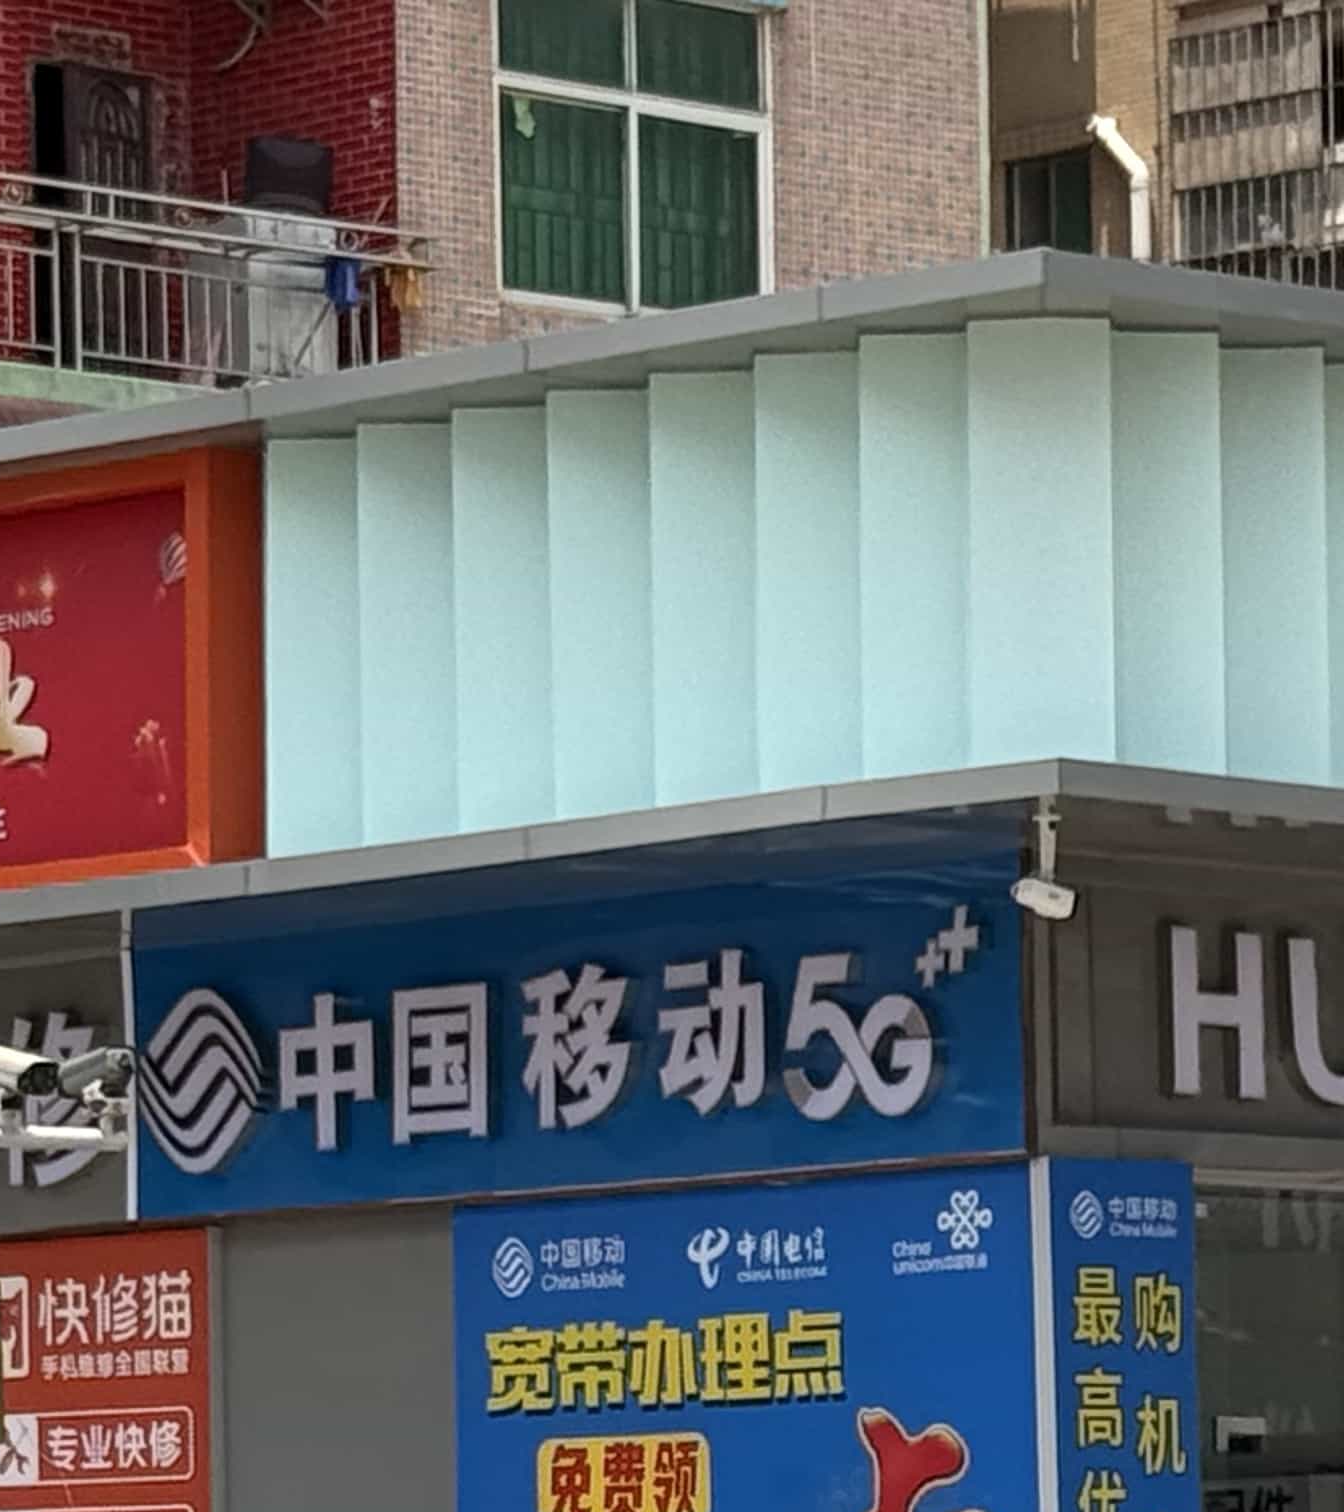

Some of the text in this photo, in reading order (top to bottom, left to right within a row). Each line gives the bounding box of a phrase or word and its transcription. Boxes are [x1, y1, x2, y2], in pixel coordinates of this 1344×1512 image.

[540, 1235, 626, 1269] 中国移动
[736, 1226, 826, 1269] 中国电信
[38, 1269, 193, 1347] 快修猫
[484, 1310, 846, 1414] 宽带办理点
[46, 1420, 182, 1472] 专业快修
